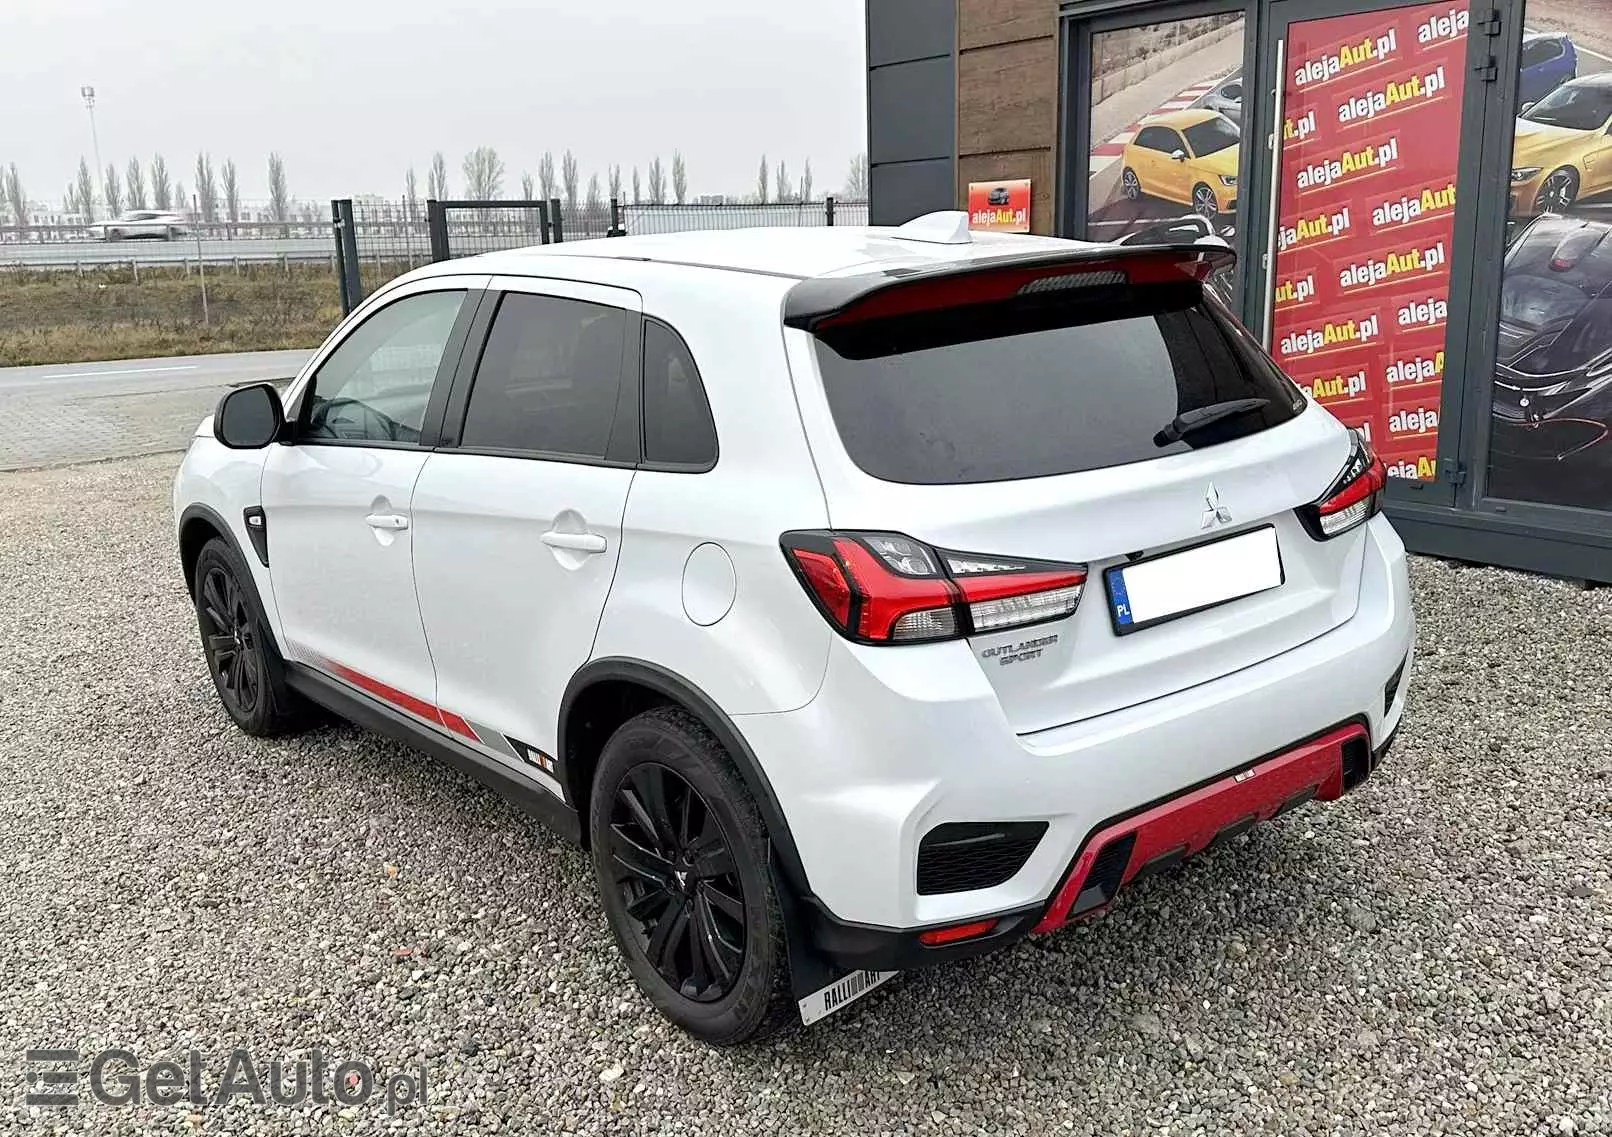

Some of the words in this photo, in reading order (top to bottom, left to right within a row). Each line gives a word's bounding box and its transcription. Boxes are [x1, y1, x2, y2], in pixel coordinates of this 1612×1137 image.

[1295, 28, 1397, 87] alejaAut.pl
[1338, 66, 1445, 123] alejaAut.pl
[1296, 137, 1398, 189] alejaAut.pl
[972, 208, 1026, 227] alejaAut.pl
[1278, 208, 1350, 251] jaAut.pl
[1339, 242, 1445, 287] alejaAut.pl
[1398, 297, 1447, 325] aleja
[1280, 315, 1379, 354] alejaAut.pl
[1300, 371, 1367, 399] aAut.pl
[1389, 407, 1440, 433] aleja
[1116, 604, 1130, 617] PL
[982, 634, 1058, 657] OUTLANDER
[1000, 648, 1043, 666] SPORT
